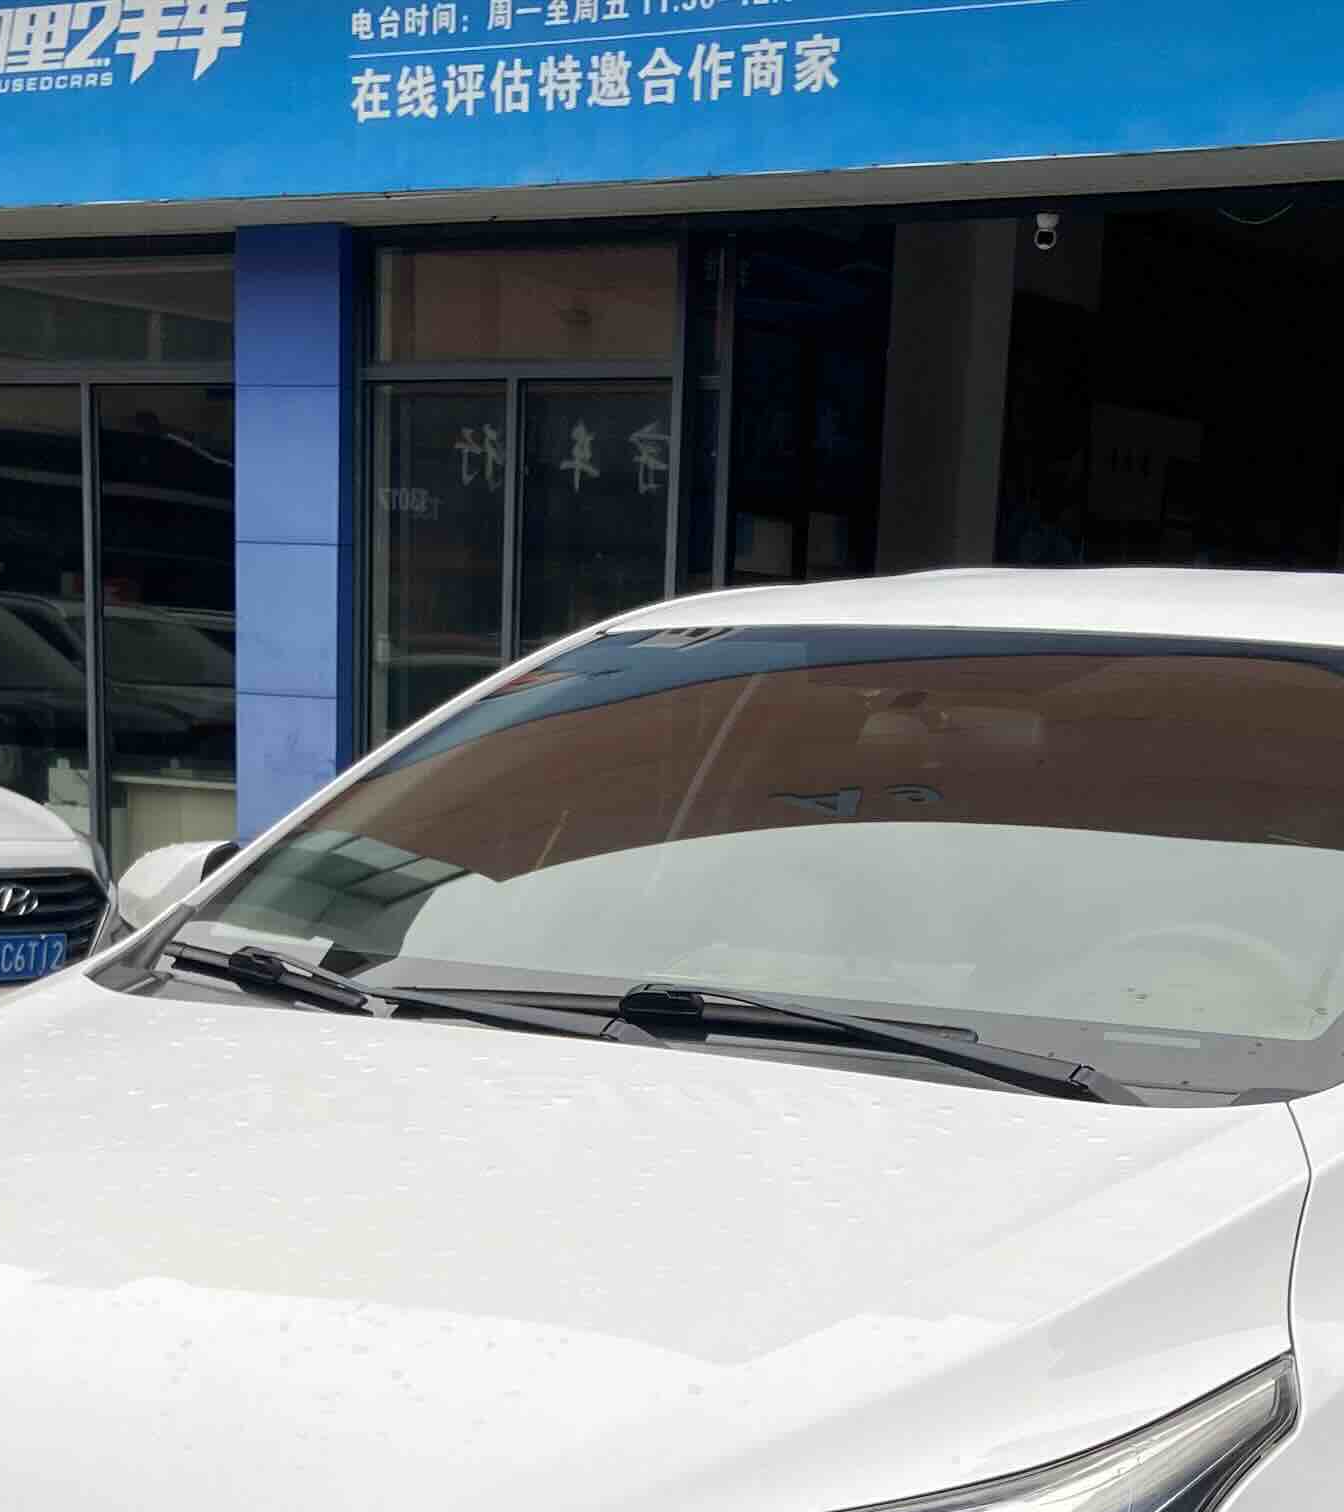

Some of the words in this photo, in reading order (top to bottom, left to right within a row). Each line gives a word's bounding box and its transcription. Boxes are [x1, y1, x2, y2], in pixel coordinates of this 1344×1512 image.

[487, 0, 630, 30] 周一至周五
[351, 34, 842, 123] 在线评估特邀合作商家
